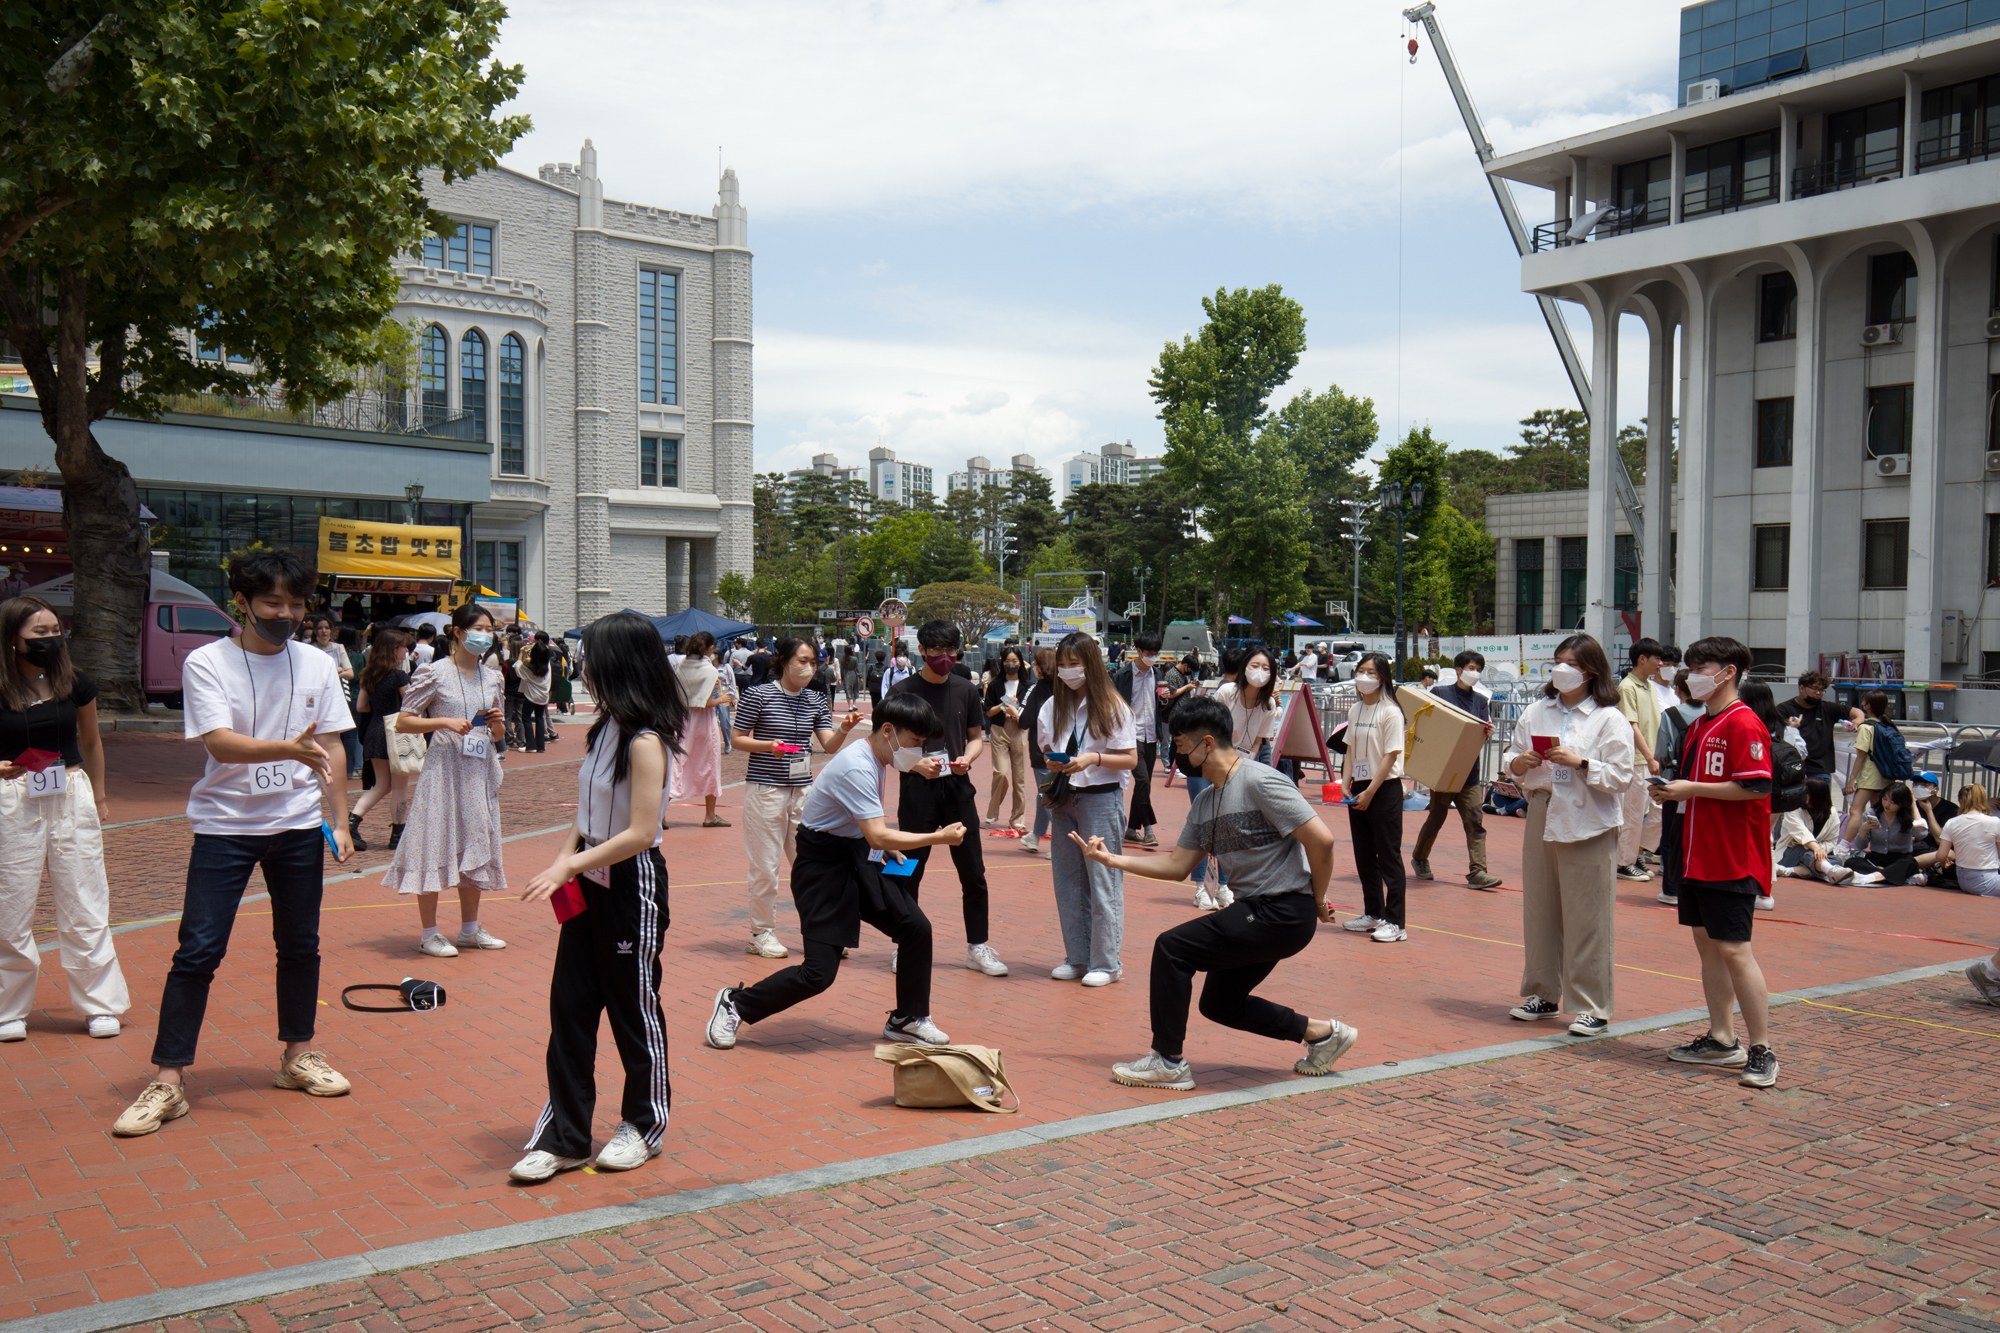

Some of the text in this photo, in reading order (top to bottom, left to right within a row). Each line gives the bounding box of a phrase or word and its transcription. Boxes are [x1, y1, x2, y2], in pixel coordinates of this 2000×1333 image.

[1425, 16, 1436, 35] KATO
[328, 531, 453, 559] 불초밥 맛집
[341, 579, 379, 590] 소고기
[398, 581, 422, 591] 초밥
[466, 738, 484, 755] 56
[1707, 736, 1728, 746] KORA
[1355, 765, 1368, 777] 75
[1705, 751, 1725, 777] 18
[33, 770, 61, 792] 91
[255, 764, 287, 789] 65
[1555, 769, 1568, 781] 98
